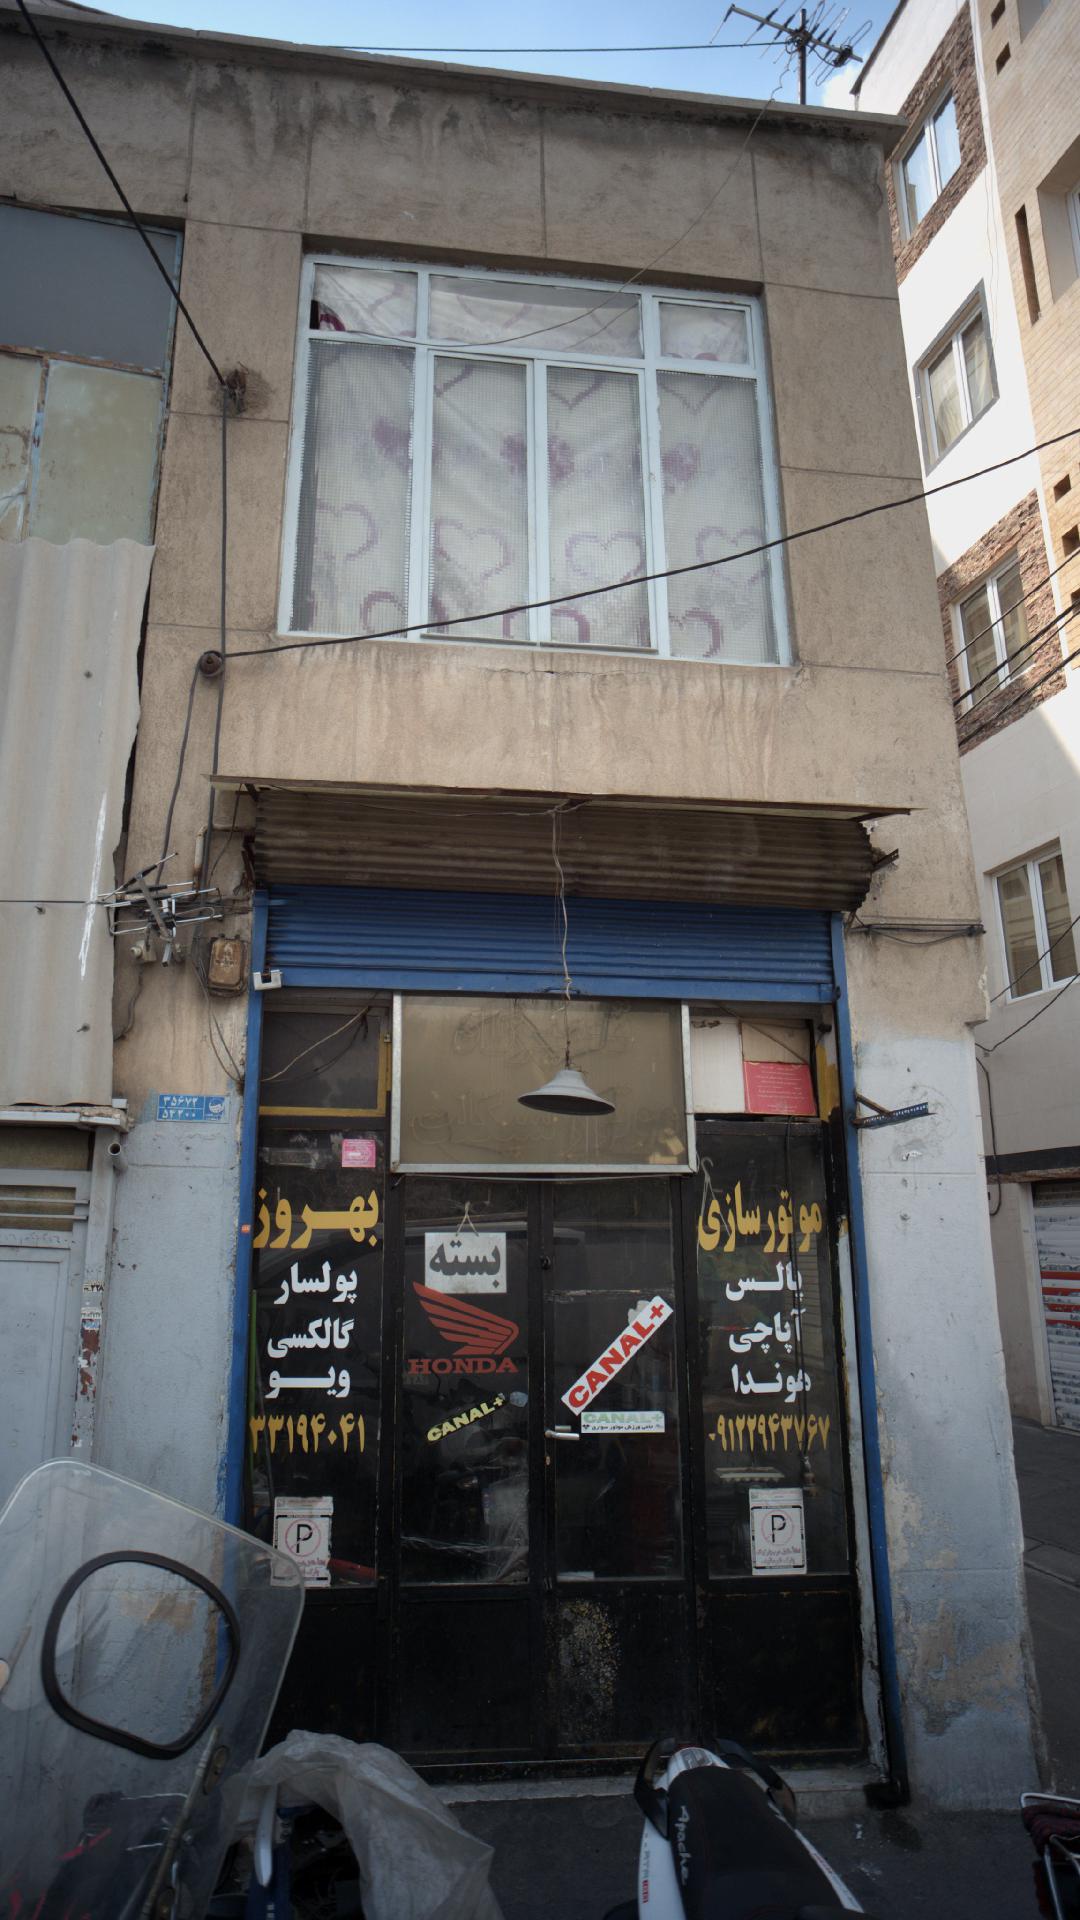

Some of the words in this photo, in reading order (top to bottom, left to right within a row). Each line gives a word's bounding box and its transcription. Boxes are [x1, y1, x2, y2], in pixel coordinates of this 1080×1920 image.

[252, 1188, 379, 1249] بهروز
[273, 1260, 358, 1304] پولسار
[429, 1240, 501, 1289] بسته
[725, 1260, 803, 1301] پالس
[266, 1316, 354, 1359] گالکسی
[728, 1308, 806, 1354] آپاچی
[408, 1357, 518, 1375] HONDA
[567, 1303, 665, 1408] CANAL+
[264, 1366, 350, 1399] ویو
[730, 1361, 812, 1403] هوندا
[249, 1412, 365, 1454] ۳۳۱۹۴۰۴۱
[708, 1412, 830, 1452] ۰۹۱۲۲۹۴۳۷۶۷
